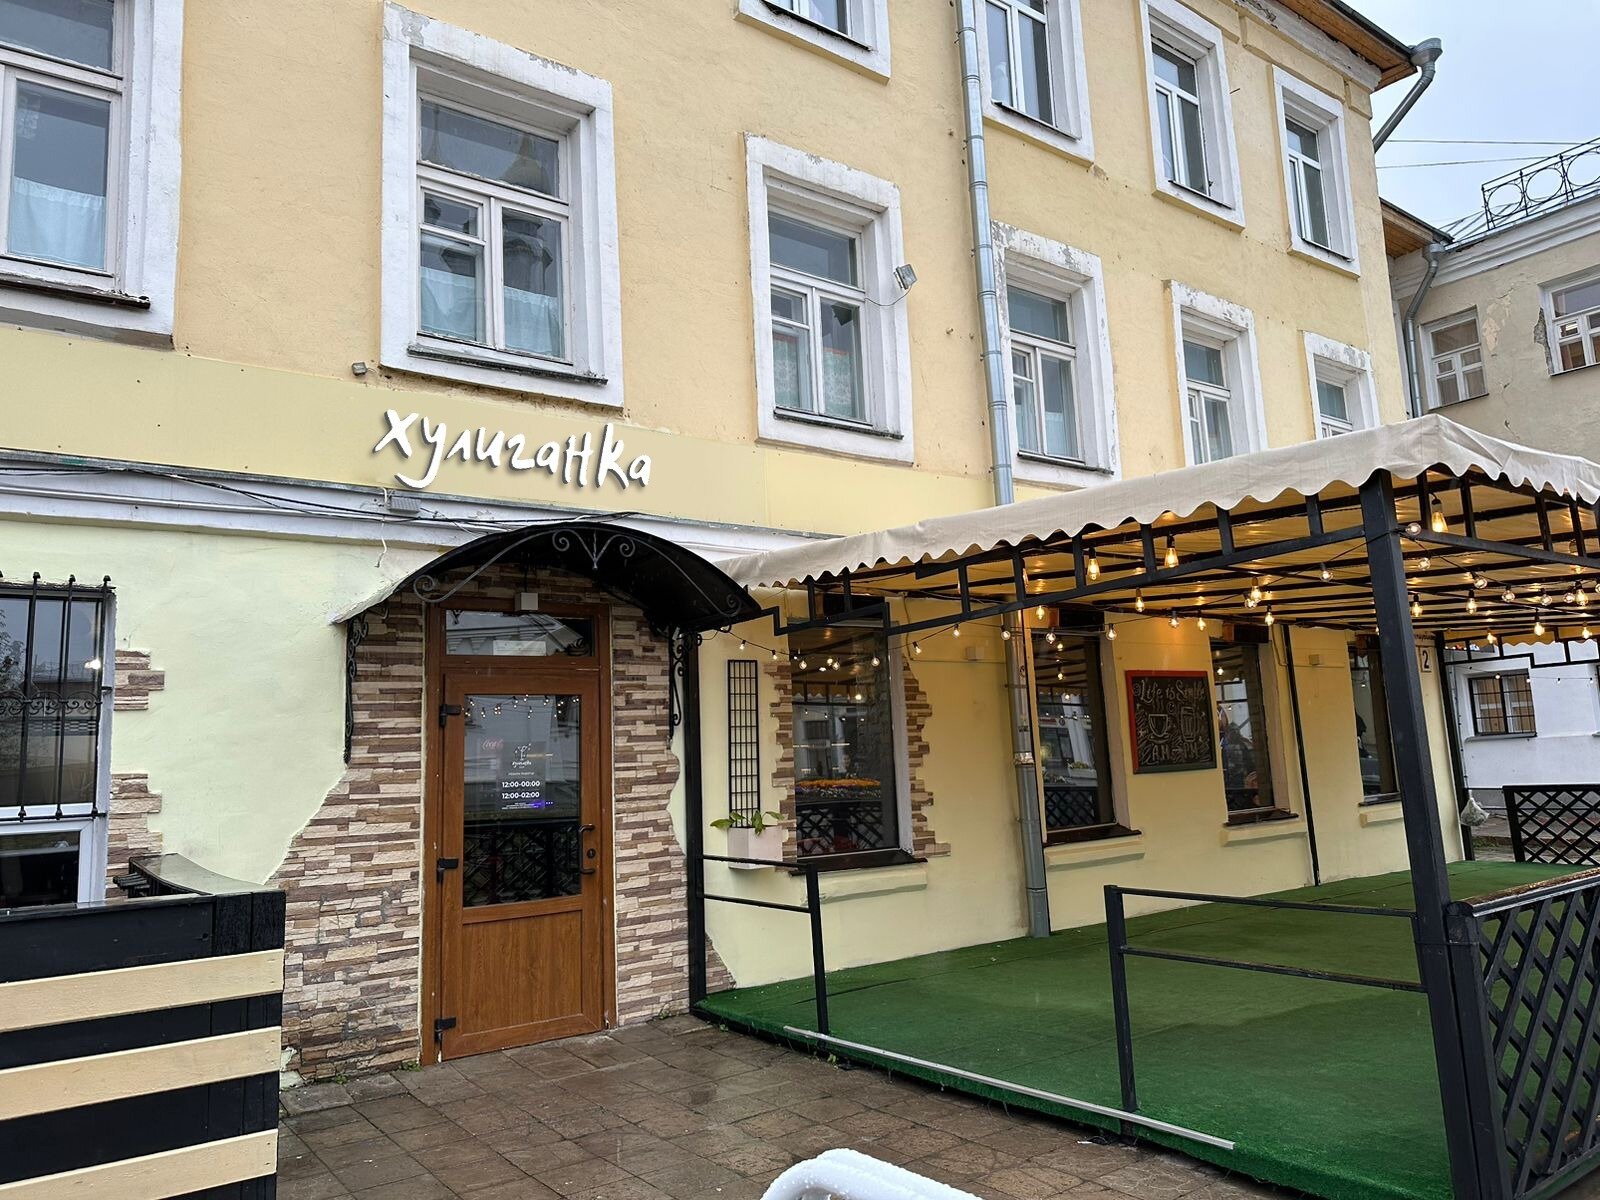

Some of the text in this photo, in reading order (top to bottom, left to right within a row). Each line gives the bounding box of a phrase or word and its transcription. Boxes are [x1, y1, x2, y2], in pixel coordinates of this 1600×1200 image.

[373, 408, 652, 489] хулиганка
[1422, 650, 1430, 669] 2
[1140, 679, 1164, 703] Life
[1165, 684, 1175, 700] is
[502, 780, 541, 788] 12:00-00:00
[502, 791, 540, 799] 12:00-02:00
